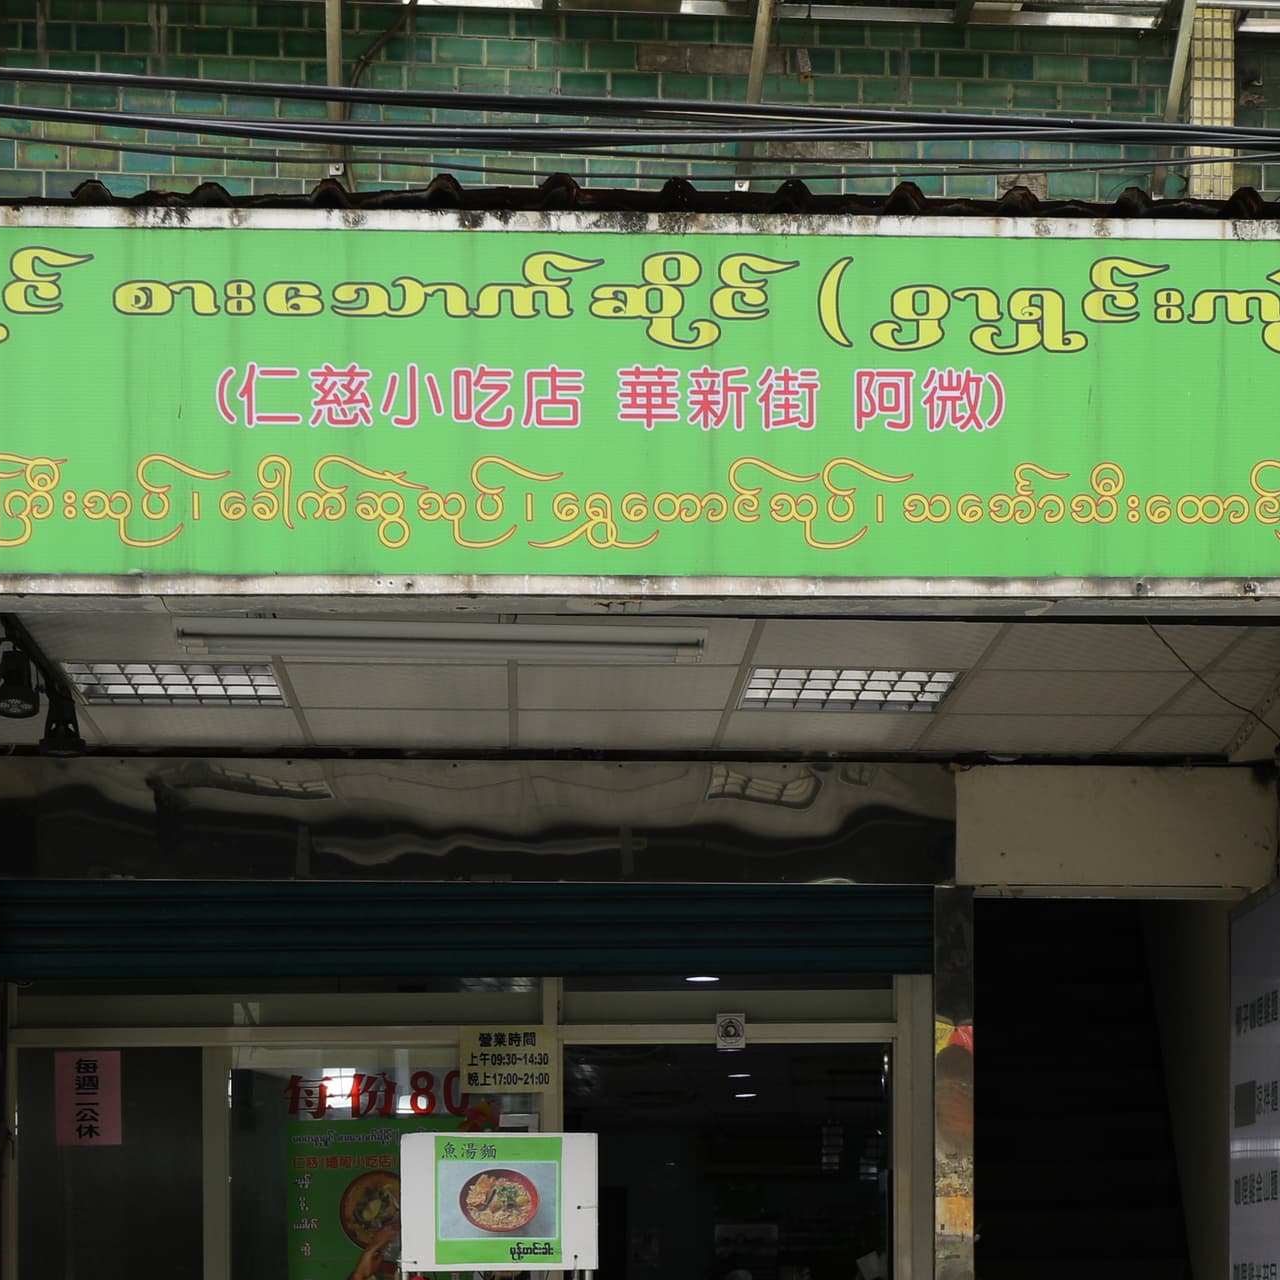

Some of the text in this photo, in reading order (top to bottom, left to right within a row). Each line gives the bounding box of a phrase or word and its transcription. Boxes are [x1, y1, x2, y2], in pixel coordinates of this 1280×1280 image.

[617, 365, 820, 432] 華新街
[478, 1031, 536, 1047] 營業時間
[467, 1052, 549, 1067] 上午09:30~14:30
[467, 1072, 550, 1087] 晚上17:00~21:00
[75, 1057, 101, 1139] 每週二公休
[440, 1142, 497, 1160] 魚湯麵
